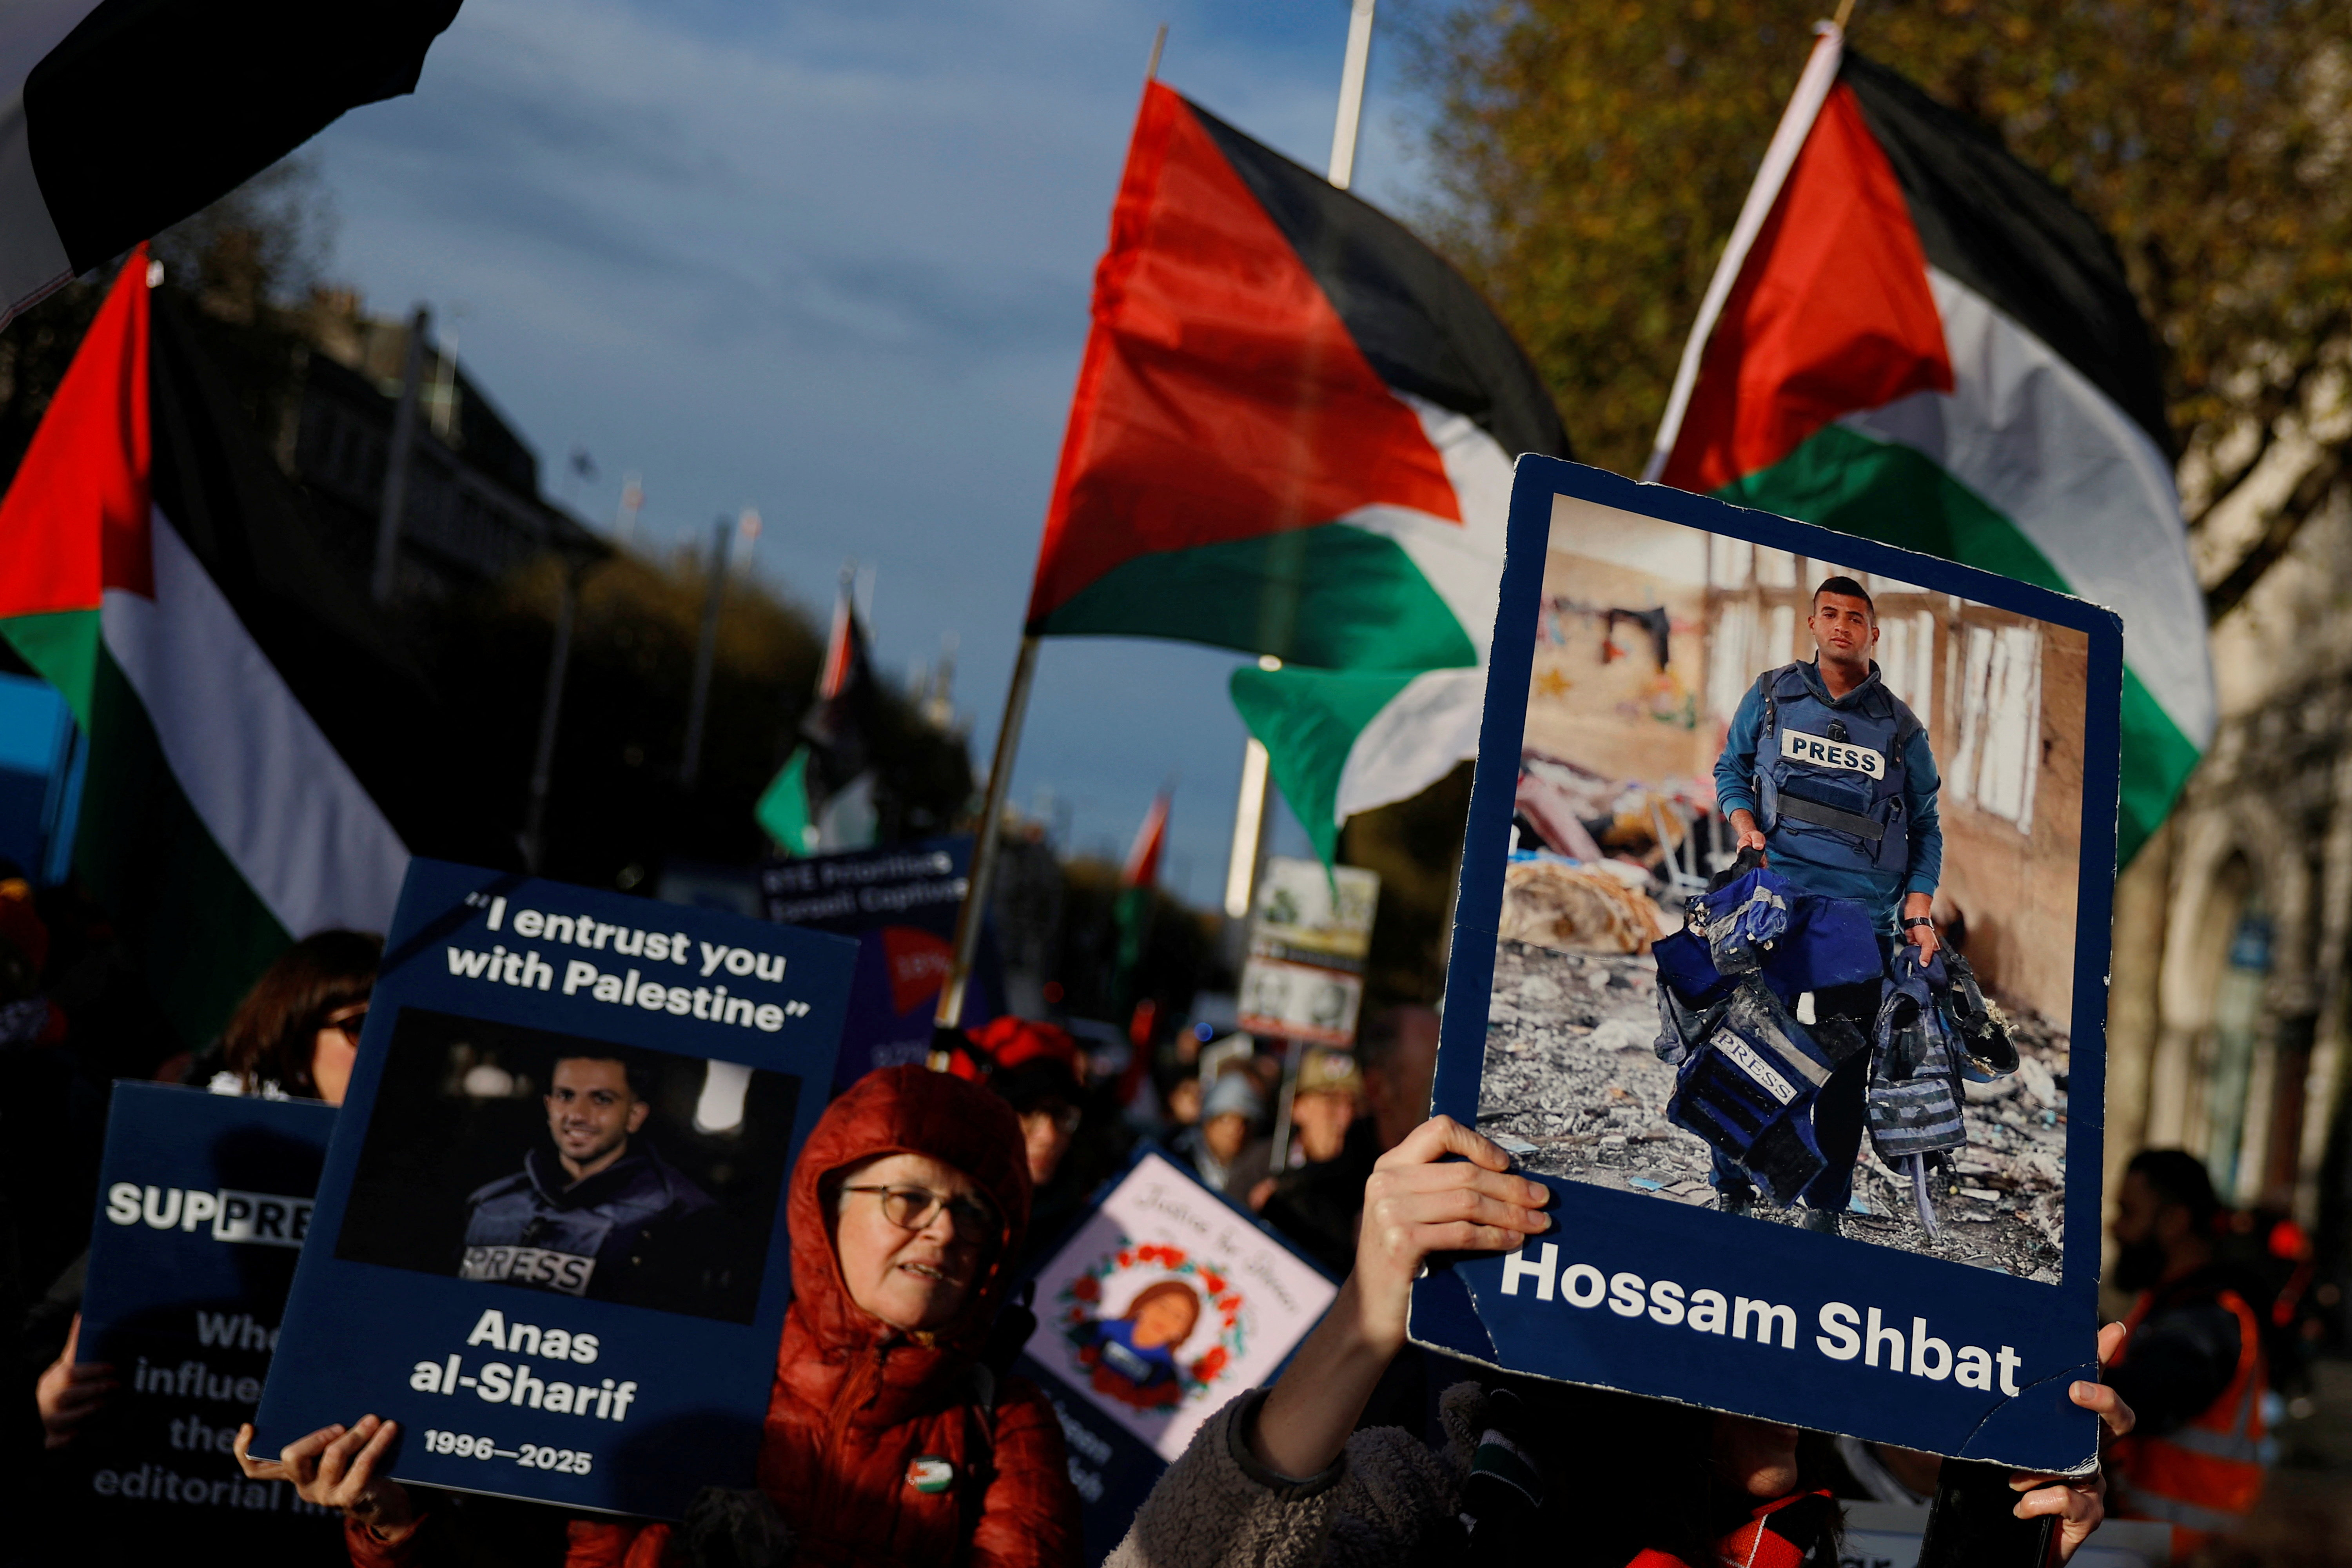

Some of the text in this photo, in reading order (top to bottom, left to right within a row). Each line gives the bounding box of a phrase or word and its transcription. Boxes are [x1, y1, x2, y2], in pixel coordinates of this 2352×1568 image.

[1793, 737, 1875, 771] PRESS
[465, 891, 786, 983] “I entrust you
[446, 945, 811, 1033] with Palestine”
[1717, 1034, 1790, 1098] PRESS
[463, 1247, 582, 1289] PRESS
[466, 1308, 600, 1364] Anas
[1500, 1241, 2021, 1397] Hossam Shbat
[409, 1353, 638, 1421] al-Sharif
[92, 1461, 282, 1512] editorial
